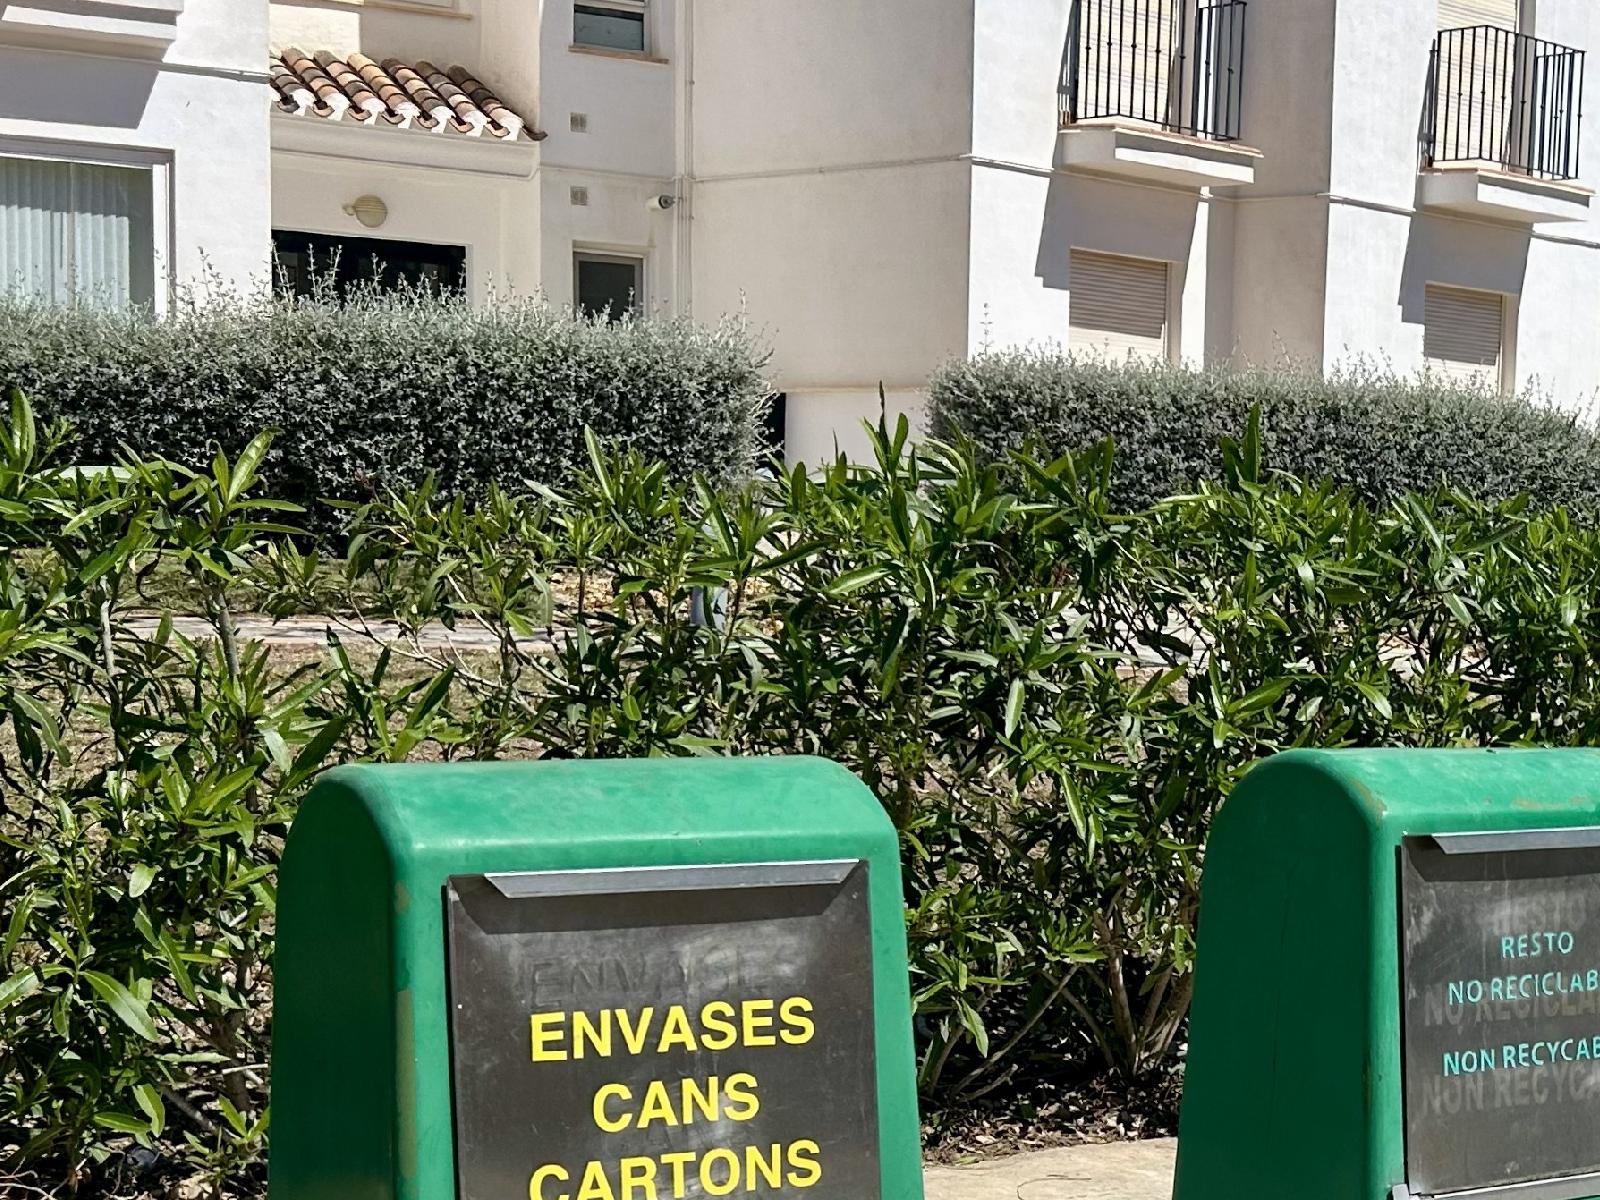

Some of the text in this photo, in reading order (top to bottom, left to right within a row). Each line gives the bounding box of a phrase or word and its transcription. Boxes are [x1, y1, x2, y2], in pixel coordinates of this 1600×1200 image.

[1501, 931, 1574, 959] RESTO
[1448, 980, 1483, 1006] NO
[530, 996, 815, 1062] ENVASES
[1443, 1049, 1496, 1077] NON
[593, 1072, 760, 1133] CANS
